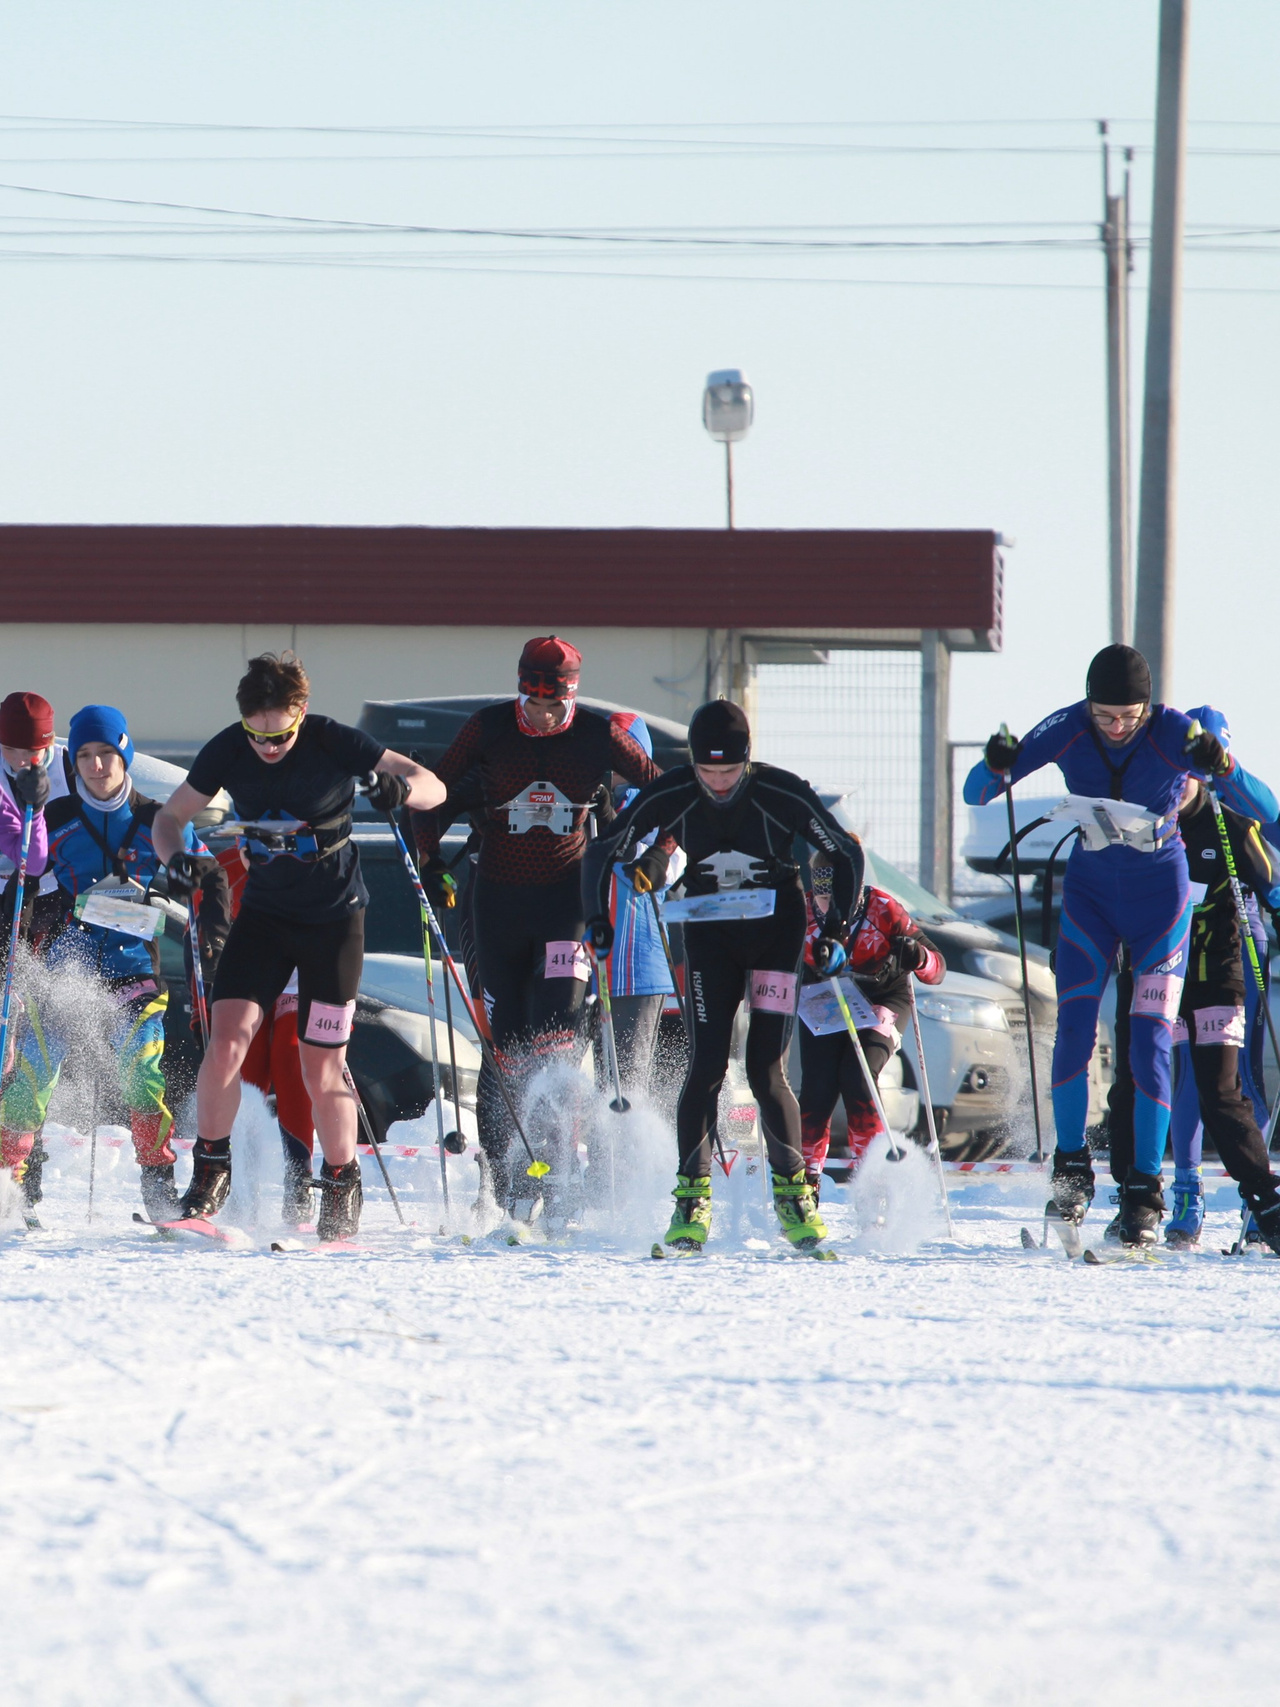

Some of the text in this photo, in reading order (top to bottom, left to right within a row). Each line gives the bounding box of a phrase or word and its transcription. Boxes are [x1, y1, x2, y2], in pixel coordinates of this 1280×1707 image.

[809, 817, 838, 853] КУРГАН
[1222, 837, 1238, 877] TEAM
[693, 970, 708, 1023] КУРГАН
[755, 984, 788, 1000] 405.1
